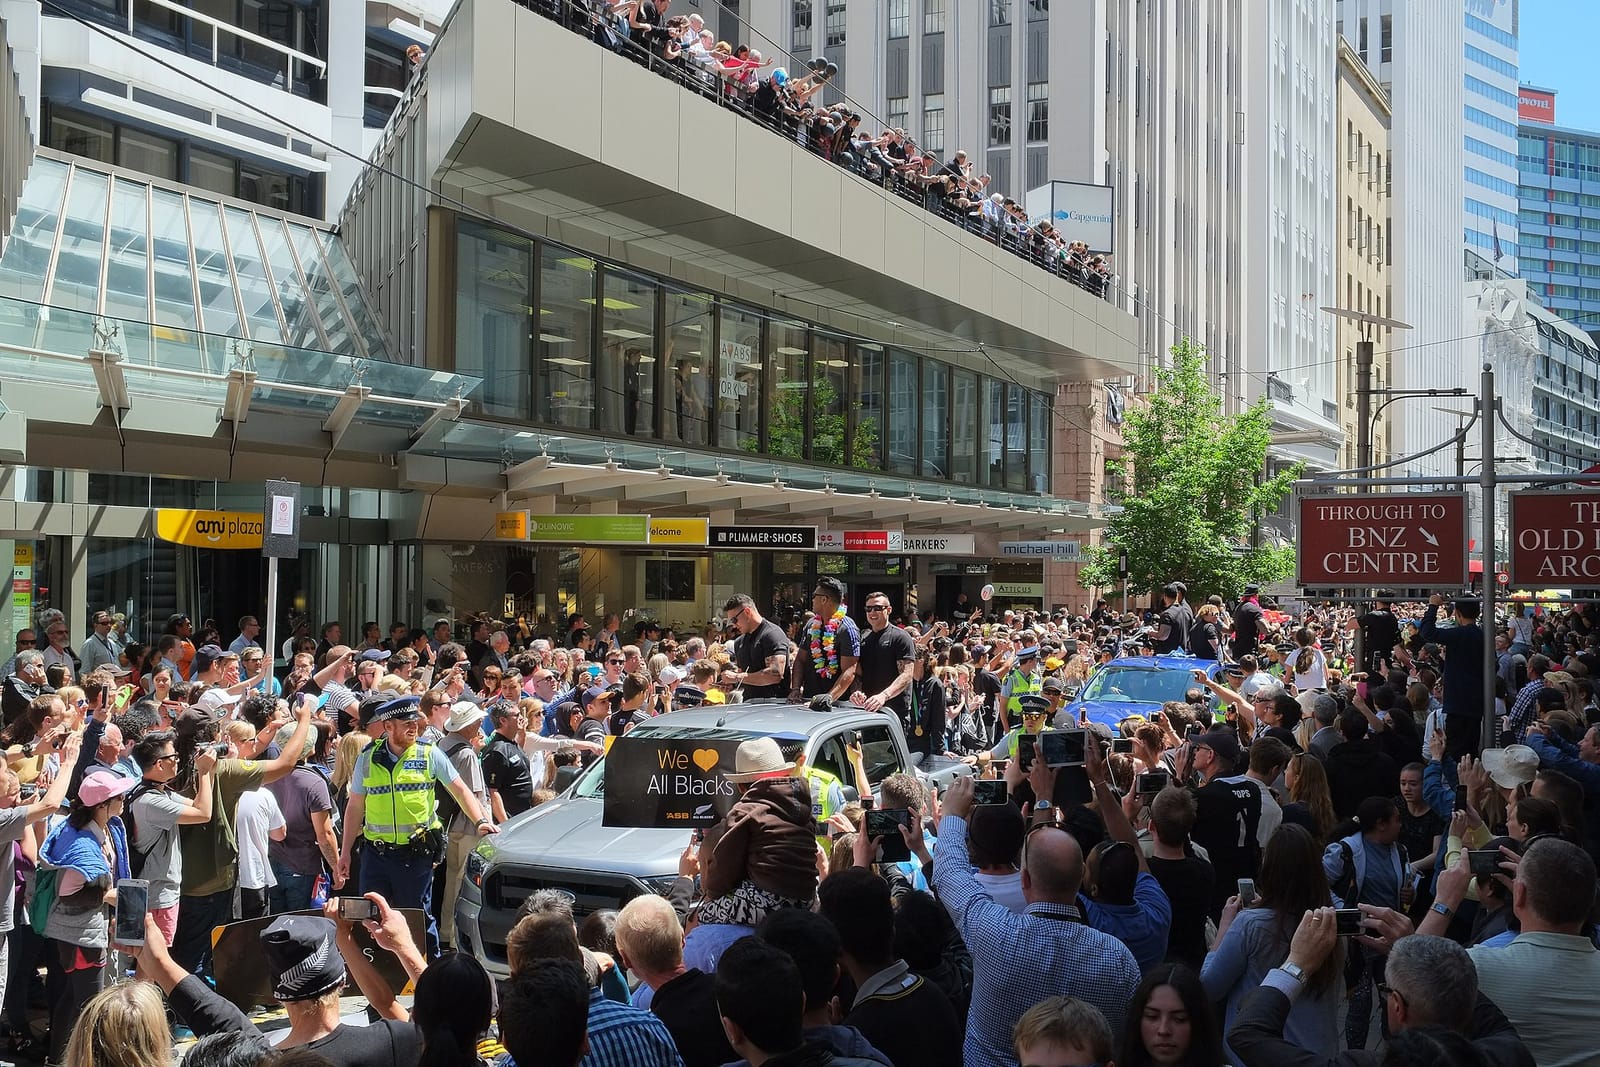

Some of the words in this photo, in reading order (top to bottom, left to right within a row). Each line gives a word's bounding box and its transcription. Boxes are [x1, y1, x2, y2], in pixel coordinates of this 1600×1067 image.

[1316, 504, 1412, 521] THROUGH
[1419, 504, 1446, 520] TO
[196, 517, 225, 534] ami
[229, 518, 262, 538] plaza
[649, 527, 682, 536] elcome
[1347, 526, 1407, 548] BNZ
[1003, 543, 1054, 554] michael
[1057, 543, 1074, 554] hill
[1518, 528, 1584, 552] OLD
[1323, 552, 1440, 574] CENTRE
[403, 761, 427, 769] POLICE
[657, 749, 689, 770] We
[647, 774, 668, 795] All
[675, 774, 735, 796] Blacks
